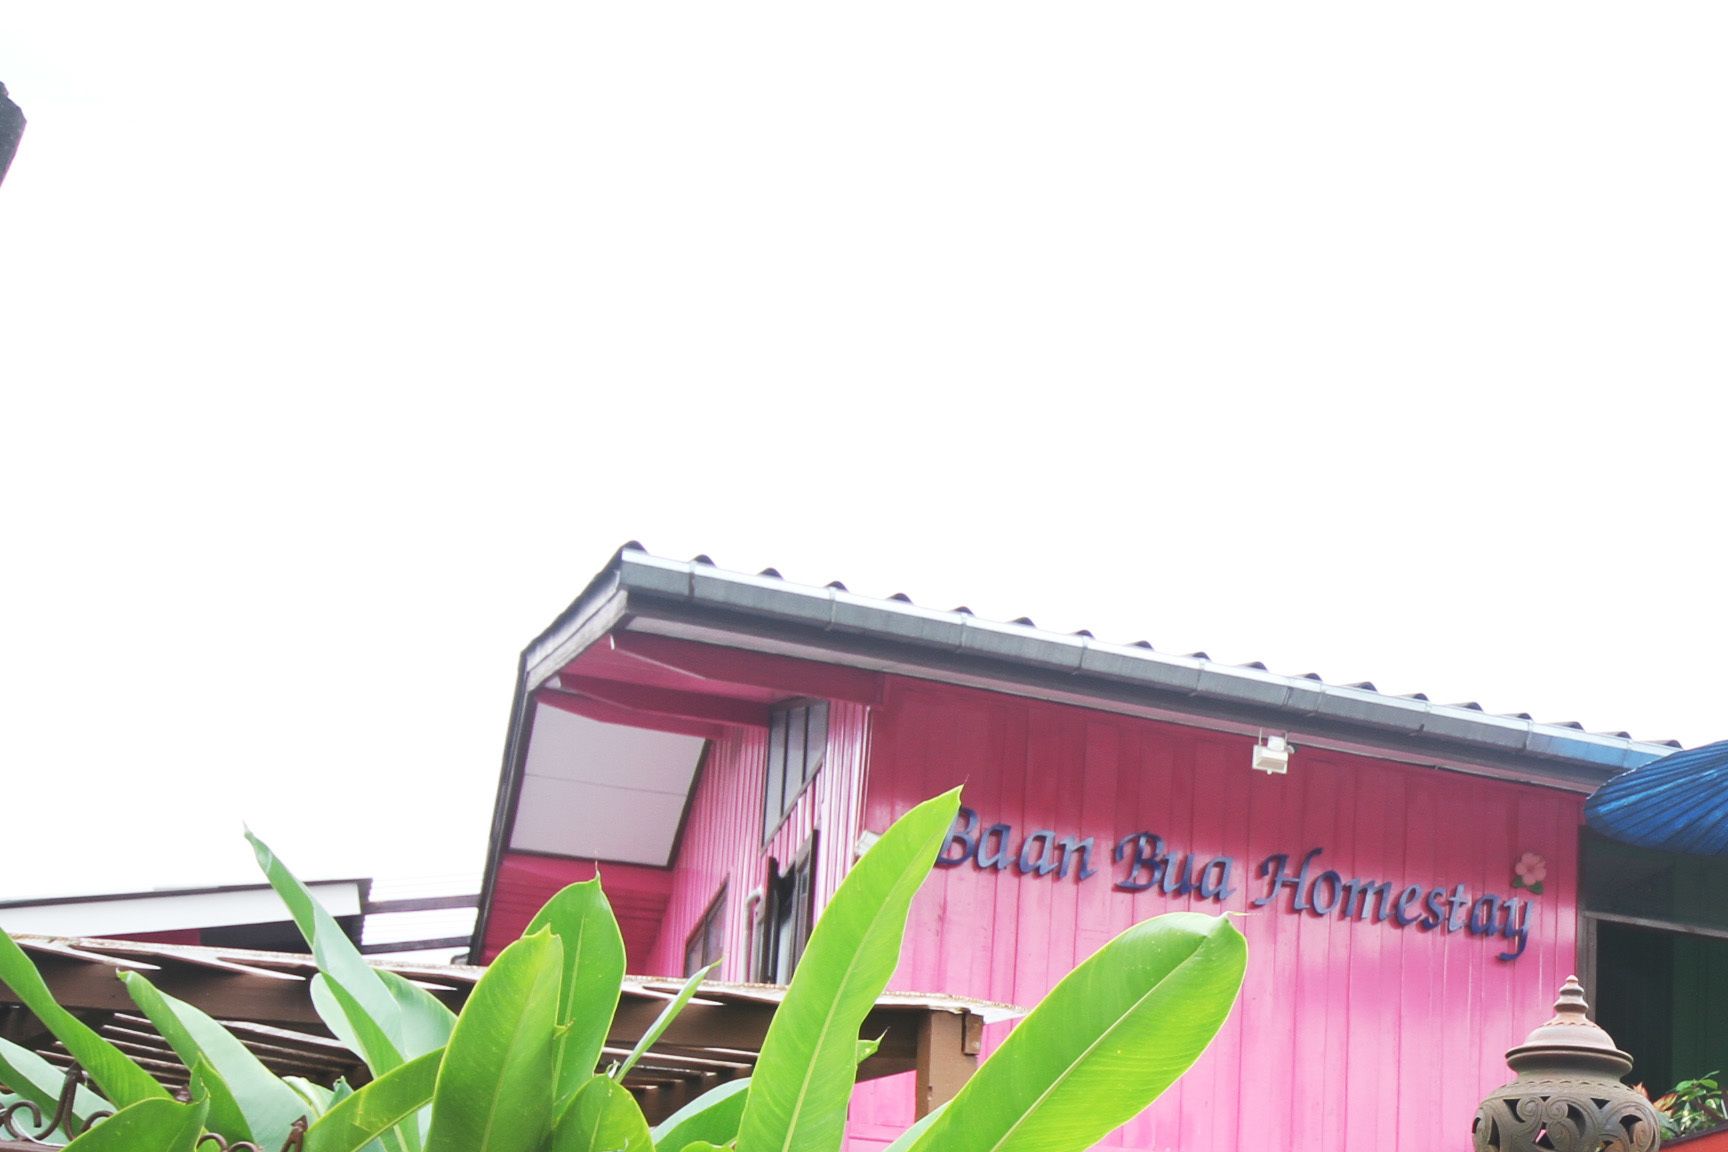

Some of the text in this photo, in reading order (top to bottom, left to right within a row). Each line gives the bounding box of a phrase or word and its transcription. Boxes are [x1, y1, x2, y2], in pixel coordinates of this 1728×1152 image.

[934, 804, 1534, 961] Baan Bua Homestay
